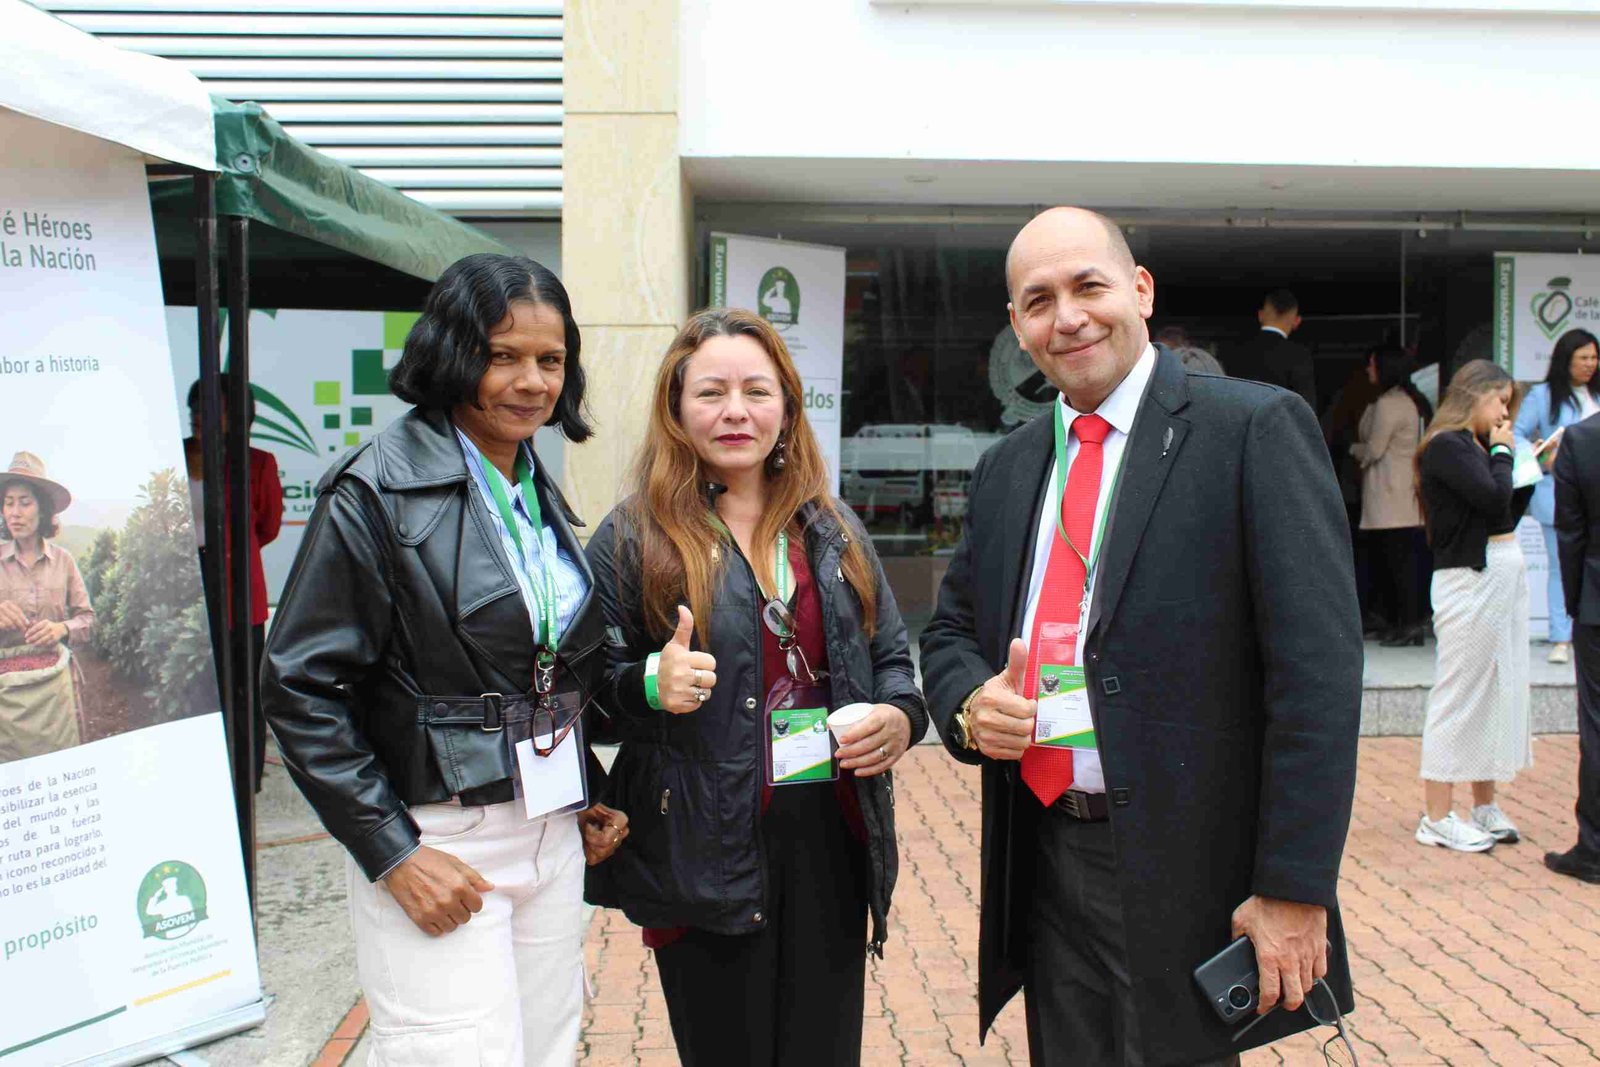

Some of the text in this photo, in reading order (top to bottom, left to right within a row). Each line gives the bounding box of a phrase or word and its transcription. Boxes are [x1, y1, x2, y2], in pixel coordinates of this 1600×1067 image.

[1, 210, 93, 240] é Héroes
[1, 241, 96, 270] la Nación
[0, 353, 100, 375] bor a historia
[28, 780, 42, 792] de
[47, 776, 58, 787] la
[48, 792, 59, 803] la
[62, 782, 98, 799] esencia
[3, 797, 100, 831] del mundo y las
[23, 830, 38, 842] de
[49, 824, 60, 835] la
[72, 813, 102, 828] fuerza
[8, 849, 31, 862] ruta
[36, 841, 60, 857] para
[41, 846, 97, 871] reconocido
[99, 844, 105, 852] a
[12, 883, 23, 895] lo
[26, 880, 38, 891] es
[41, 875, 51, 887] la
[54, 863, 91, 883] calidad
[92, 857, 107, 871] del
[155, 911, 195, 932] ASOVEM
[4, 914, 98, 961] propósito
